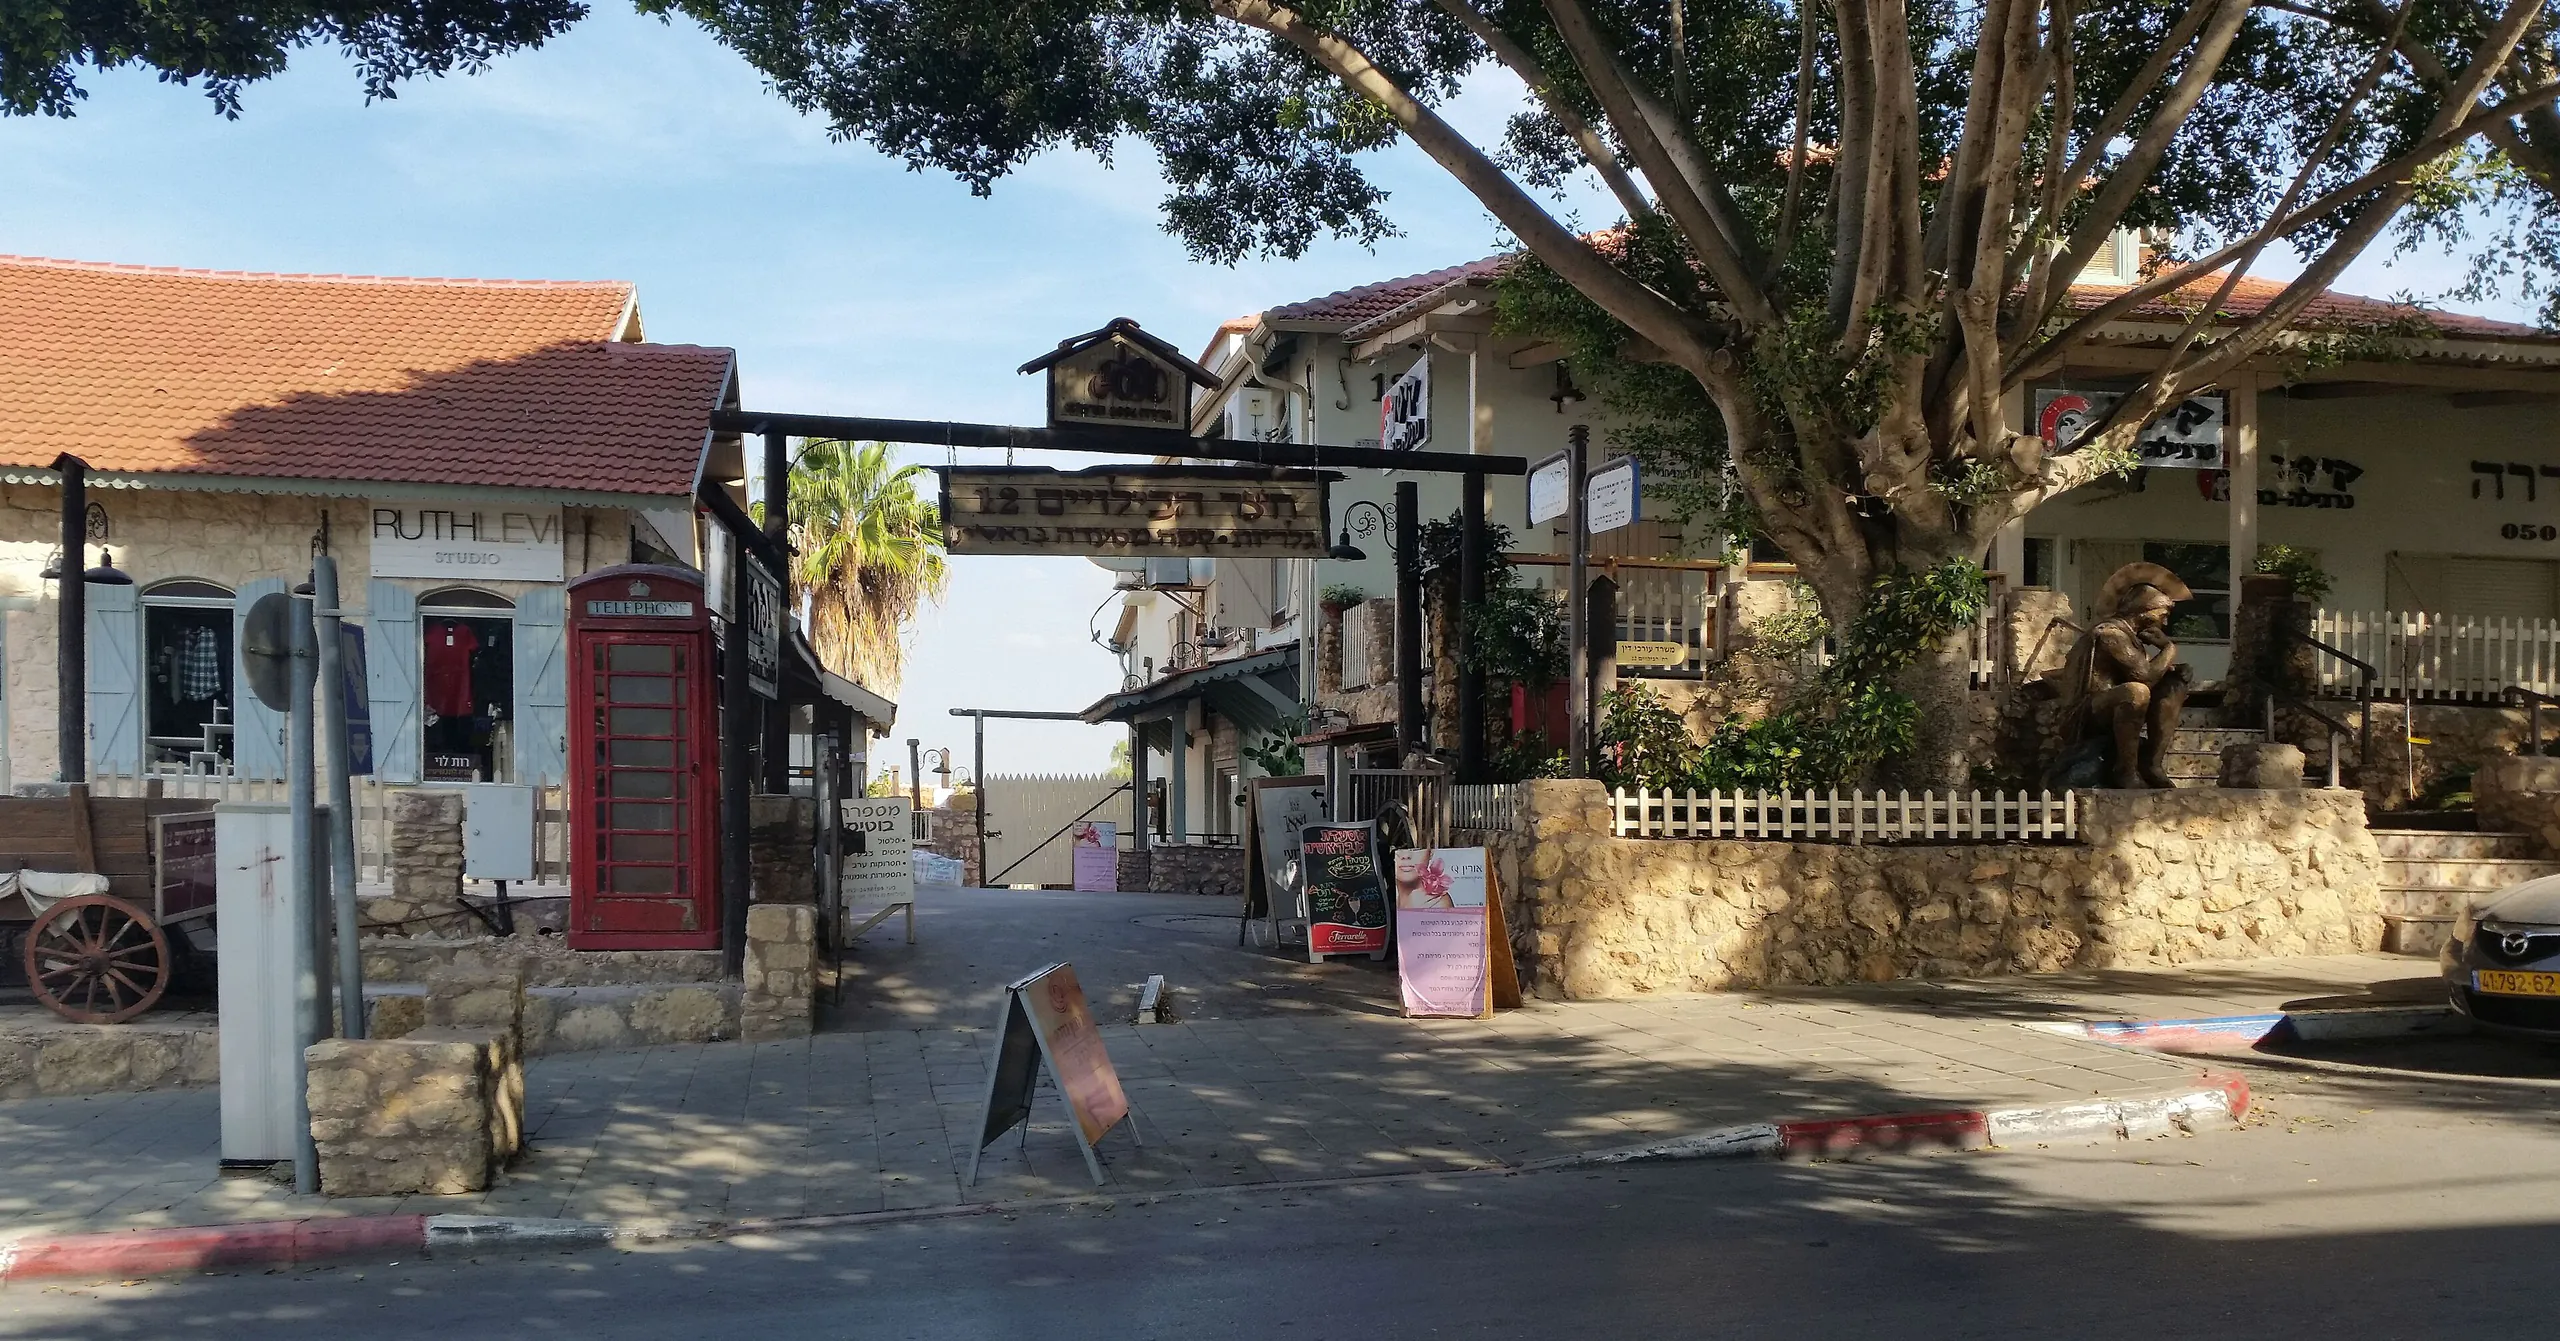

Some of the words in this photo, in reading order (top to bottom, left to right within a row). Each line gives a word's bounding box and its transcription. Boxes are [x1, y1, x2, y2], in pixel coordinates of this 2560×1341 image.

[2470, 459, 2560, 502] רה
[975, 486, 1020, 515] 12
[434, 551, 500, 566] STUDIO
[593, 601, 687, 614] TELEPHONE
[1621, 645, 1632, 653] דין
[1634, 645, 1654, 653] עורכי
[1655, 645, 1675, 653] משרד
[434, 755, 449, 767] לוי
[451, 756, 470, 767] רות
[877, 837, 900, 845] סלסול
[1462, 865, 1483, 876] אורין
